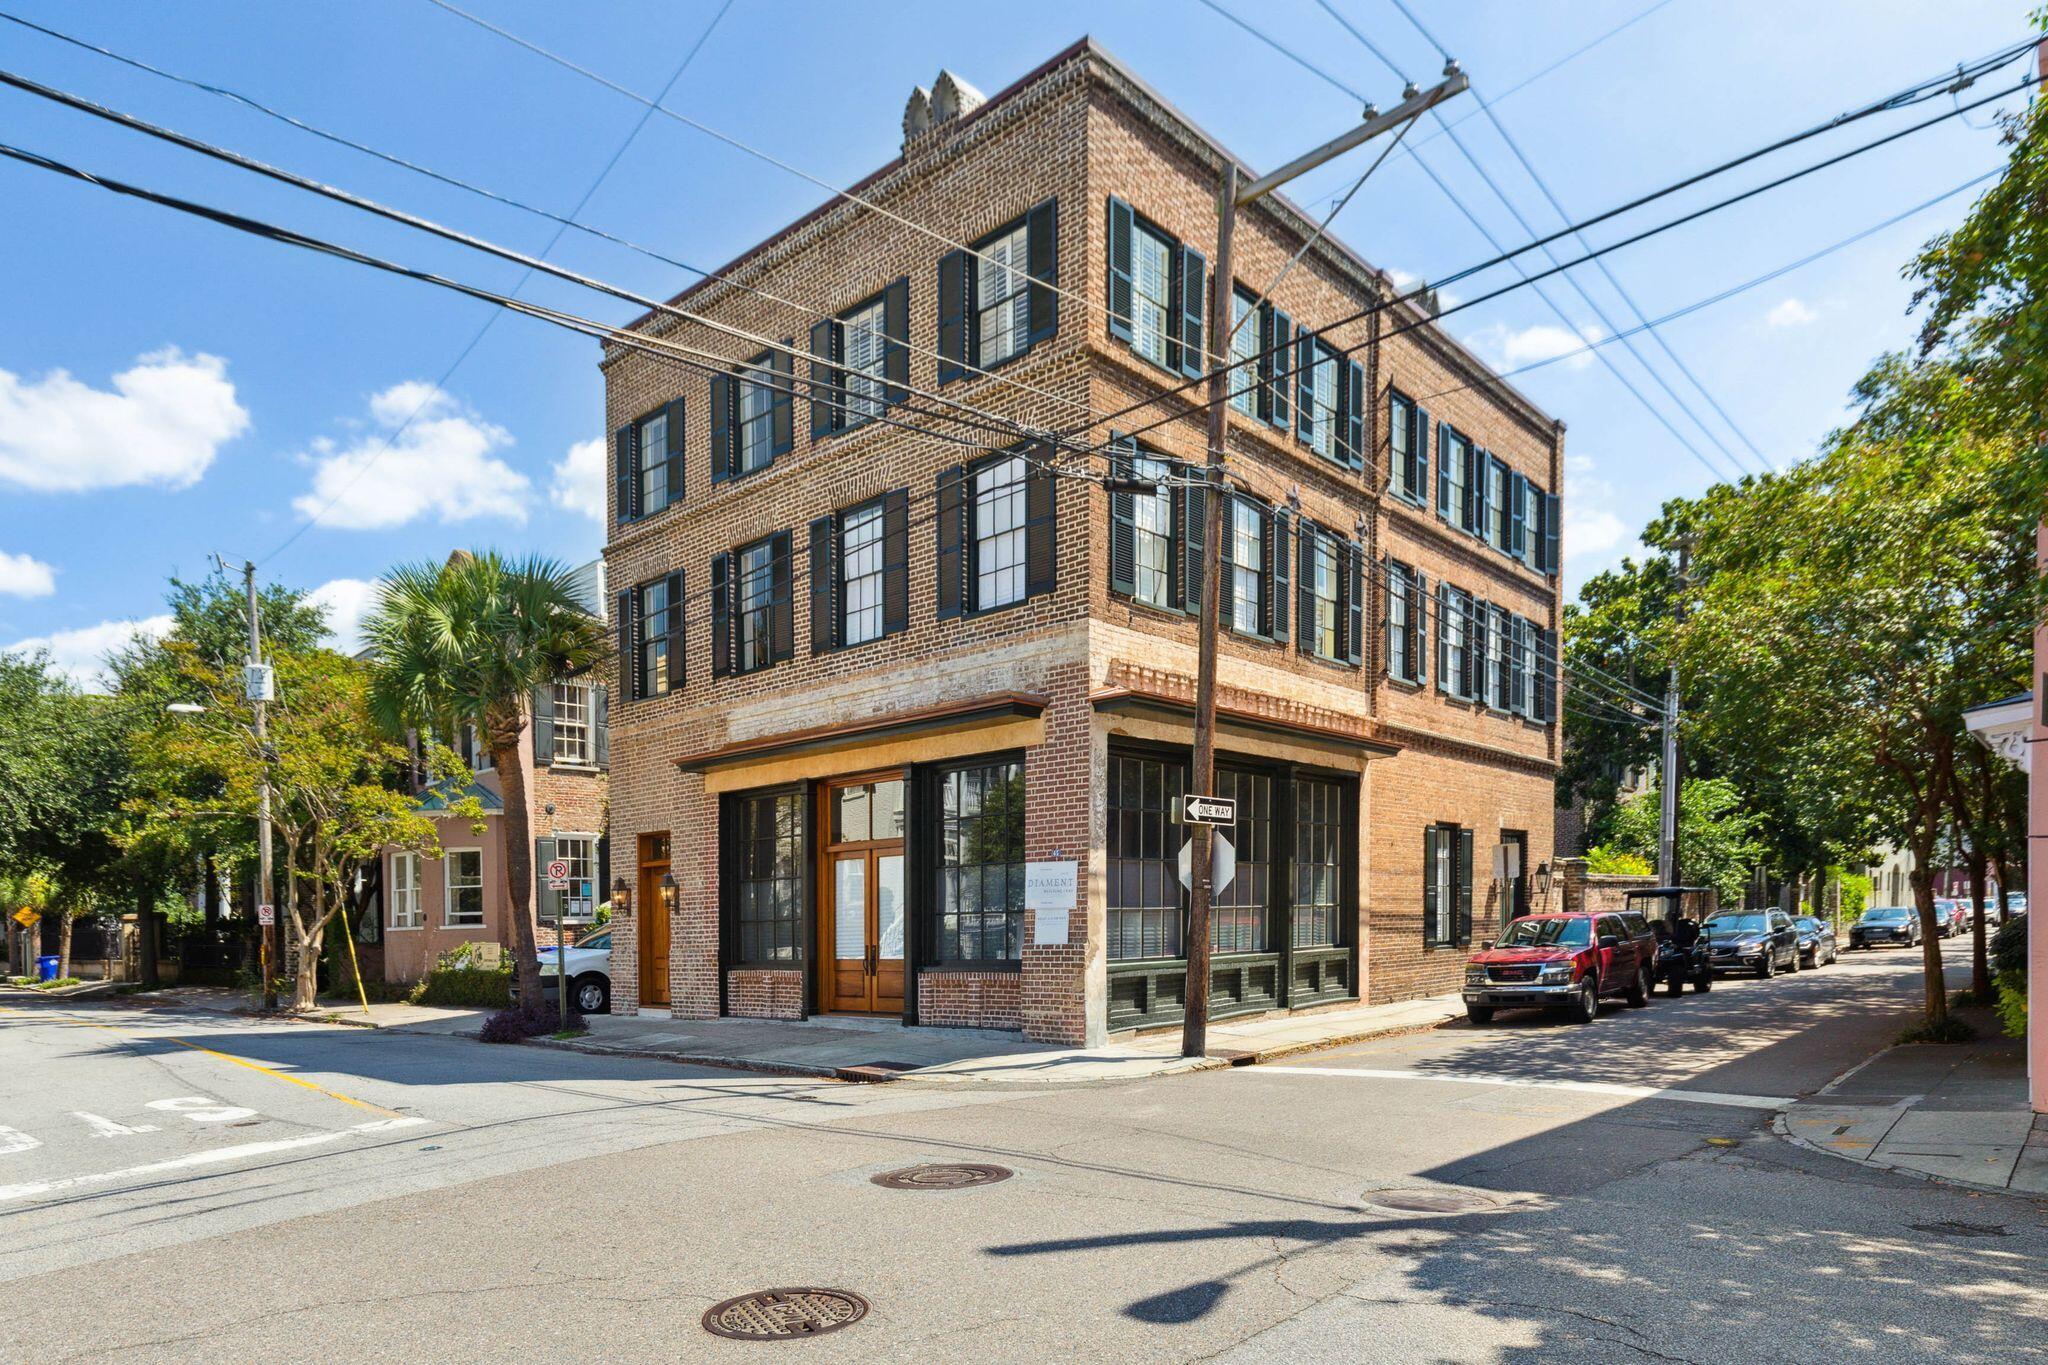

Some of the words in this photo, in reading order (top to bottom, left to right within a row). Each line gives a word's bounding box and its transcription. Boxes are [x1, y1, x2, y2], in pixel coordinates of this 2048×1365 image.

[1199, 805, 1213, 816] ONE
[1214, 806, 1230, 817] WAY
[1028, 878, 1073, 888] DIAMENT
